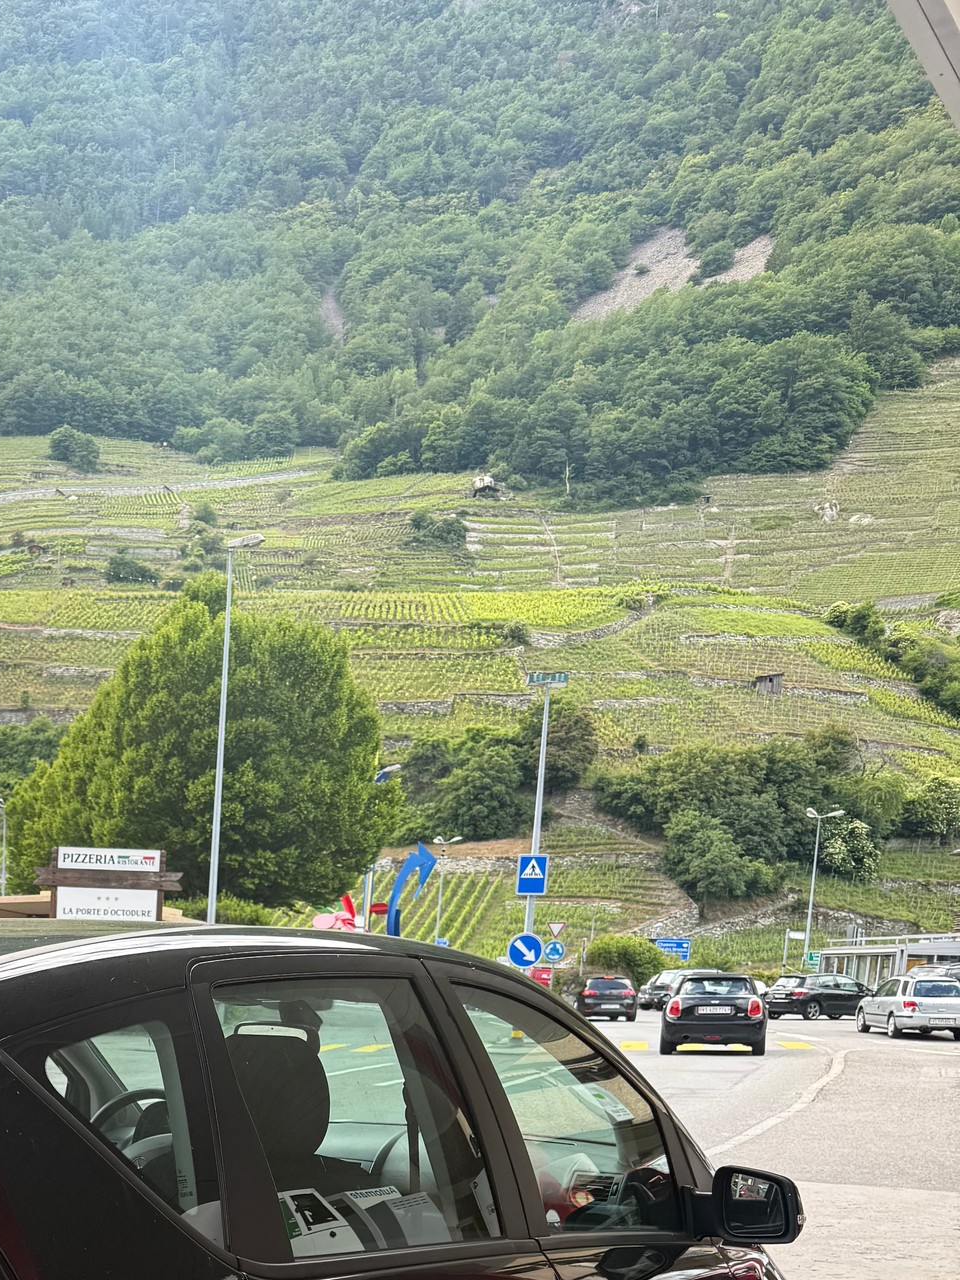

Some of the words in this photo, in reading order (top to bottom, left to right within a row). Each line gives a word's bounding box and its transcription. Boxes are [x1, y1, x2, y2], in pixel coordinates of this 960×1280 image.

[62, 853, 116, 865] PIZZERIA
[117, 859, 156, 867] RISTORANTE
[62, 907, 74, 915] LA
[76, 908, 102, 916] PORTE
[103, 908, 153, 918] D'OCTODURE
